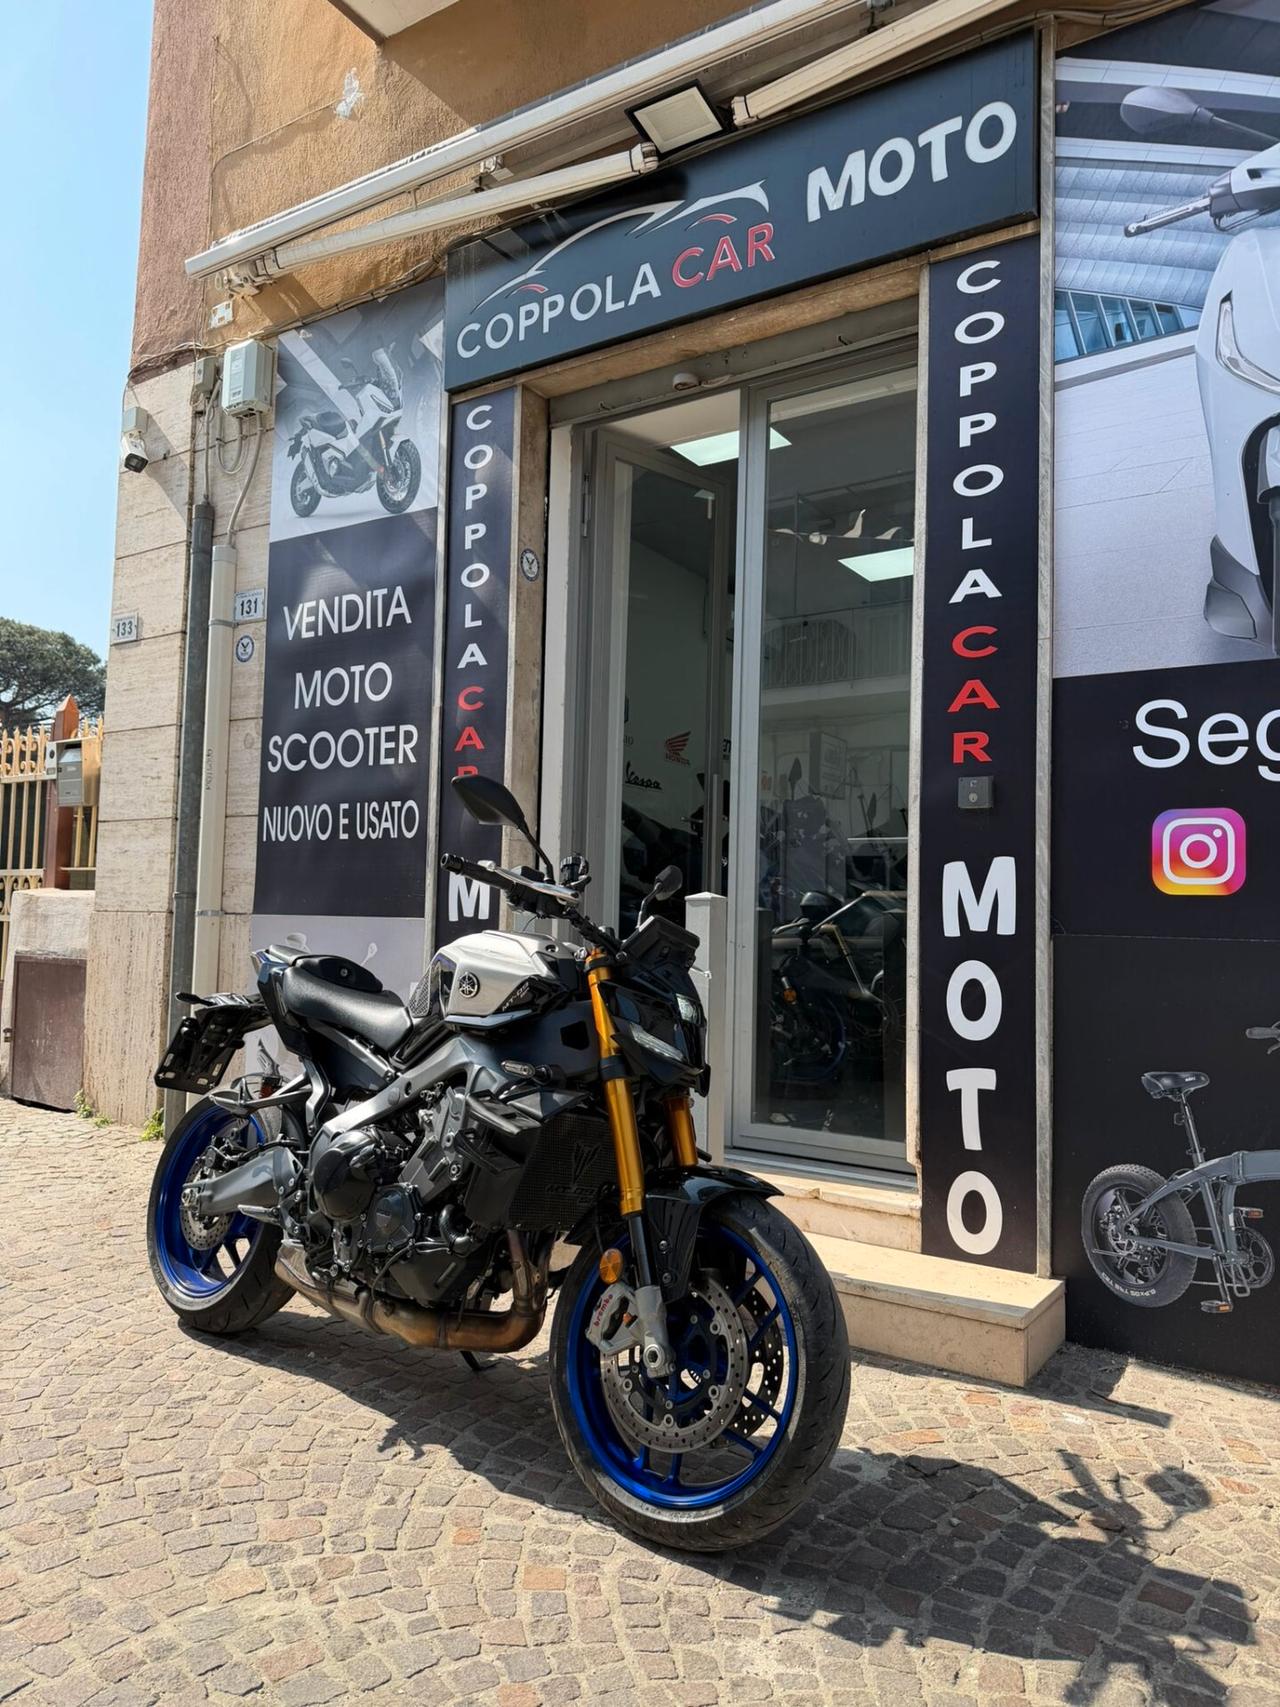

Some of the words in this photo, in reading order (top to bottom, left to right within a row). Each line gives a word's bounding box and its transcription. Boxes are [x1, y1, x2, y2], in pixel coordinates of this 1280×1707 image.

[456, 262, 662, 359] COPPOLA
[671, 222, 776, 289] CAR
[806, 101, 1017, 223] MOTO
[949, 260, 1005, 604] COPPOLA
[457, 404, 494, 669] COPPOLA
[117, 620, 133, 637] 133
[240, 598, 258, 616] 131
[283, 585, 412, 641] VENDITA
[294, 661, 393, 710] MOTO
[948, 625, 999, 764] CAR
[267, 724, 419, 773] SCOOTER
[625, 761, 662, 790] Vespa
[263, 803, 333, 842] NUOVO
[339, 804, 350, 840] E
[356, 799, 420, 840] USATO
[942, 856, 1017, 1255] MOTO
